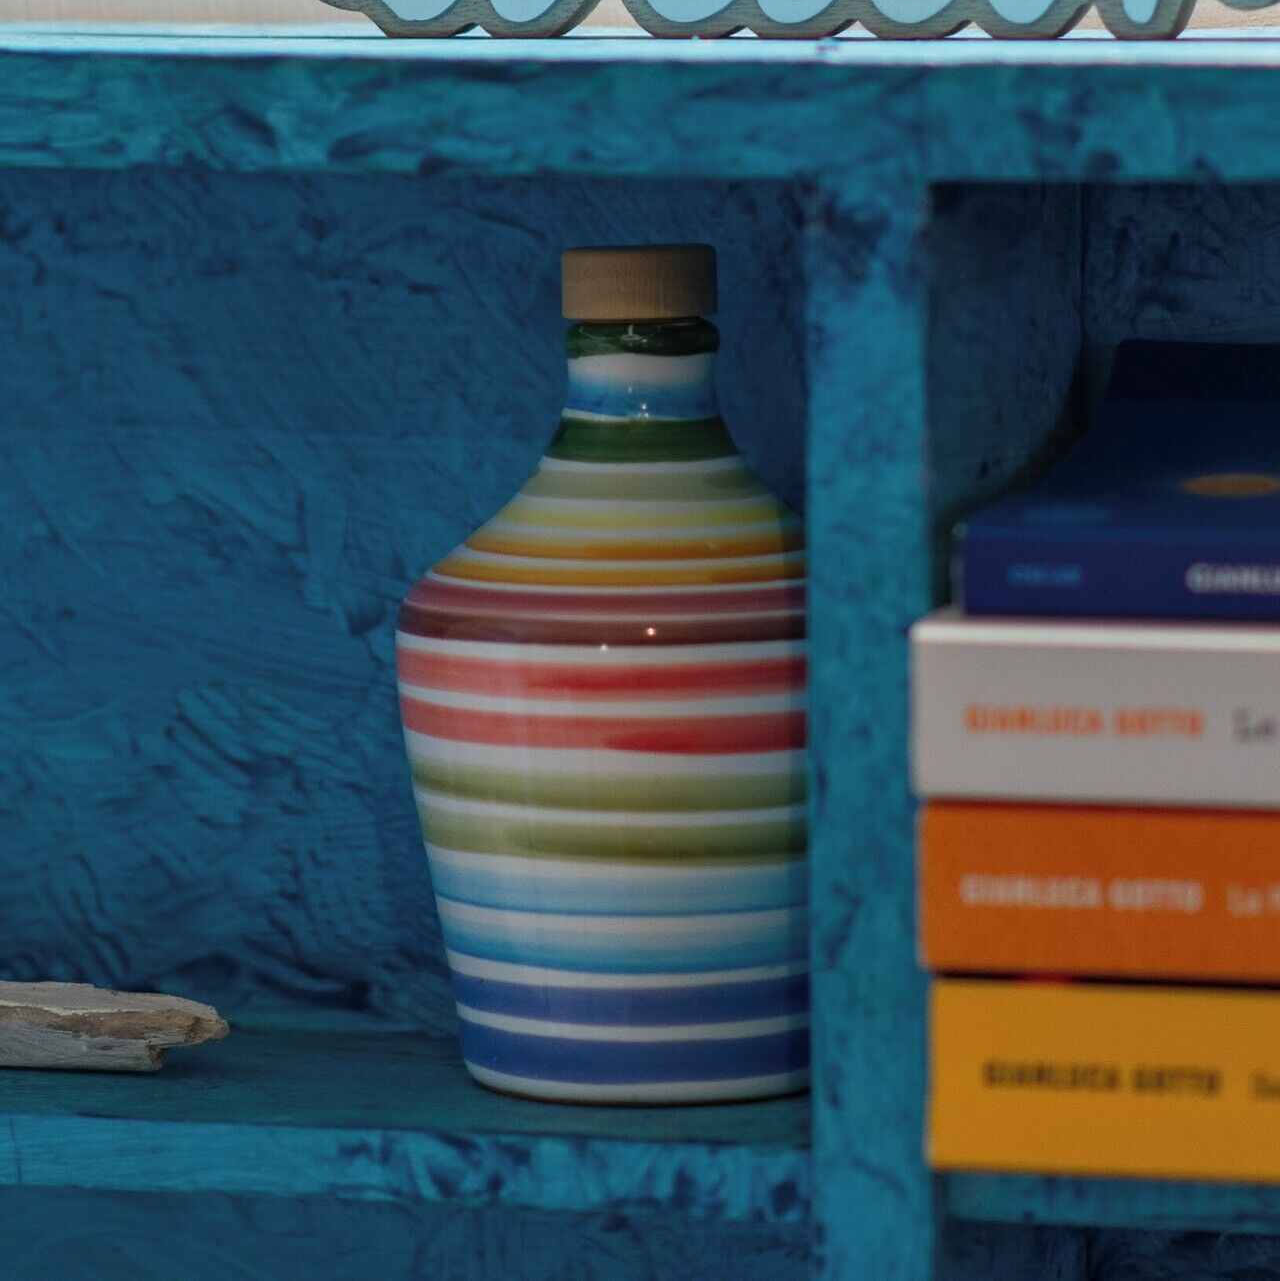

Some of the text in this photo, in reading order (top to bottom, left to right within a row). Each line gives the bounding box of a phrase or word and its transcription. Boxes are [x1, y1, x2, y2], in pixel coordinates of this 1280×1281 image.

[1110, 706, 1206, 739] GOTTO
[1108, 878, 1204, 913] GOTTO
[981, 1059, 1122, 1093] GIANLUCA
[1129, 1064, 1222, 1098] GOTTO
